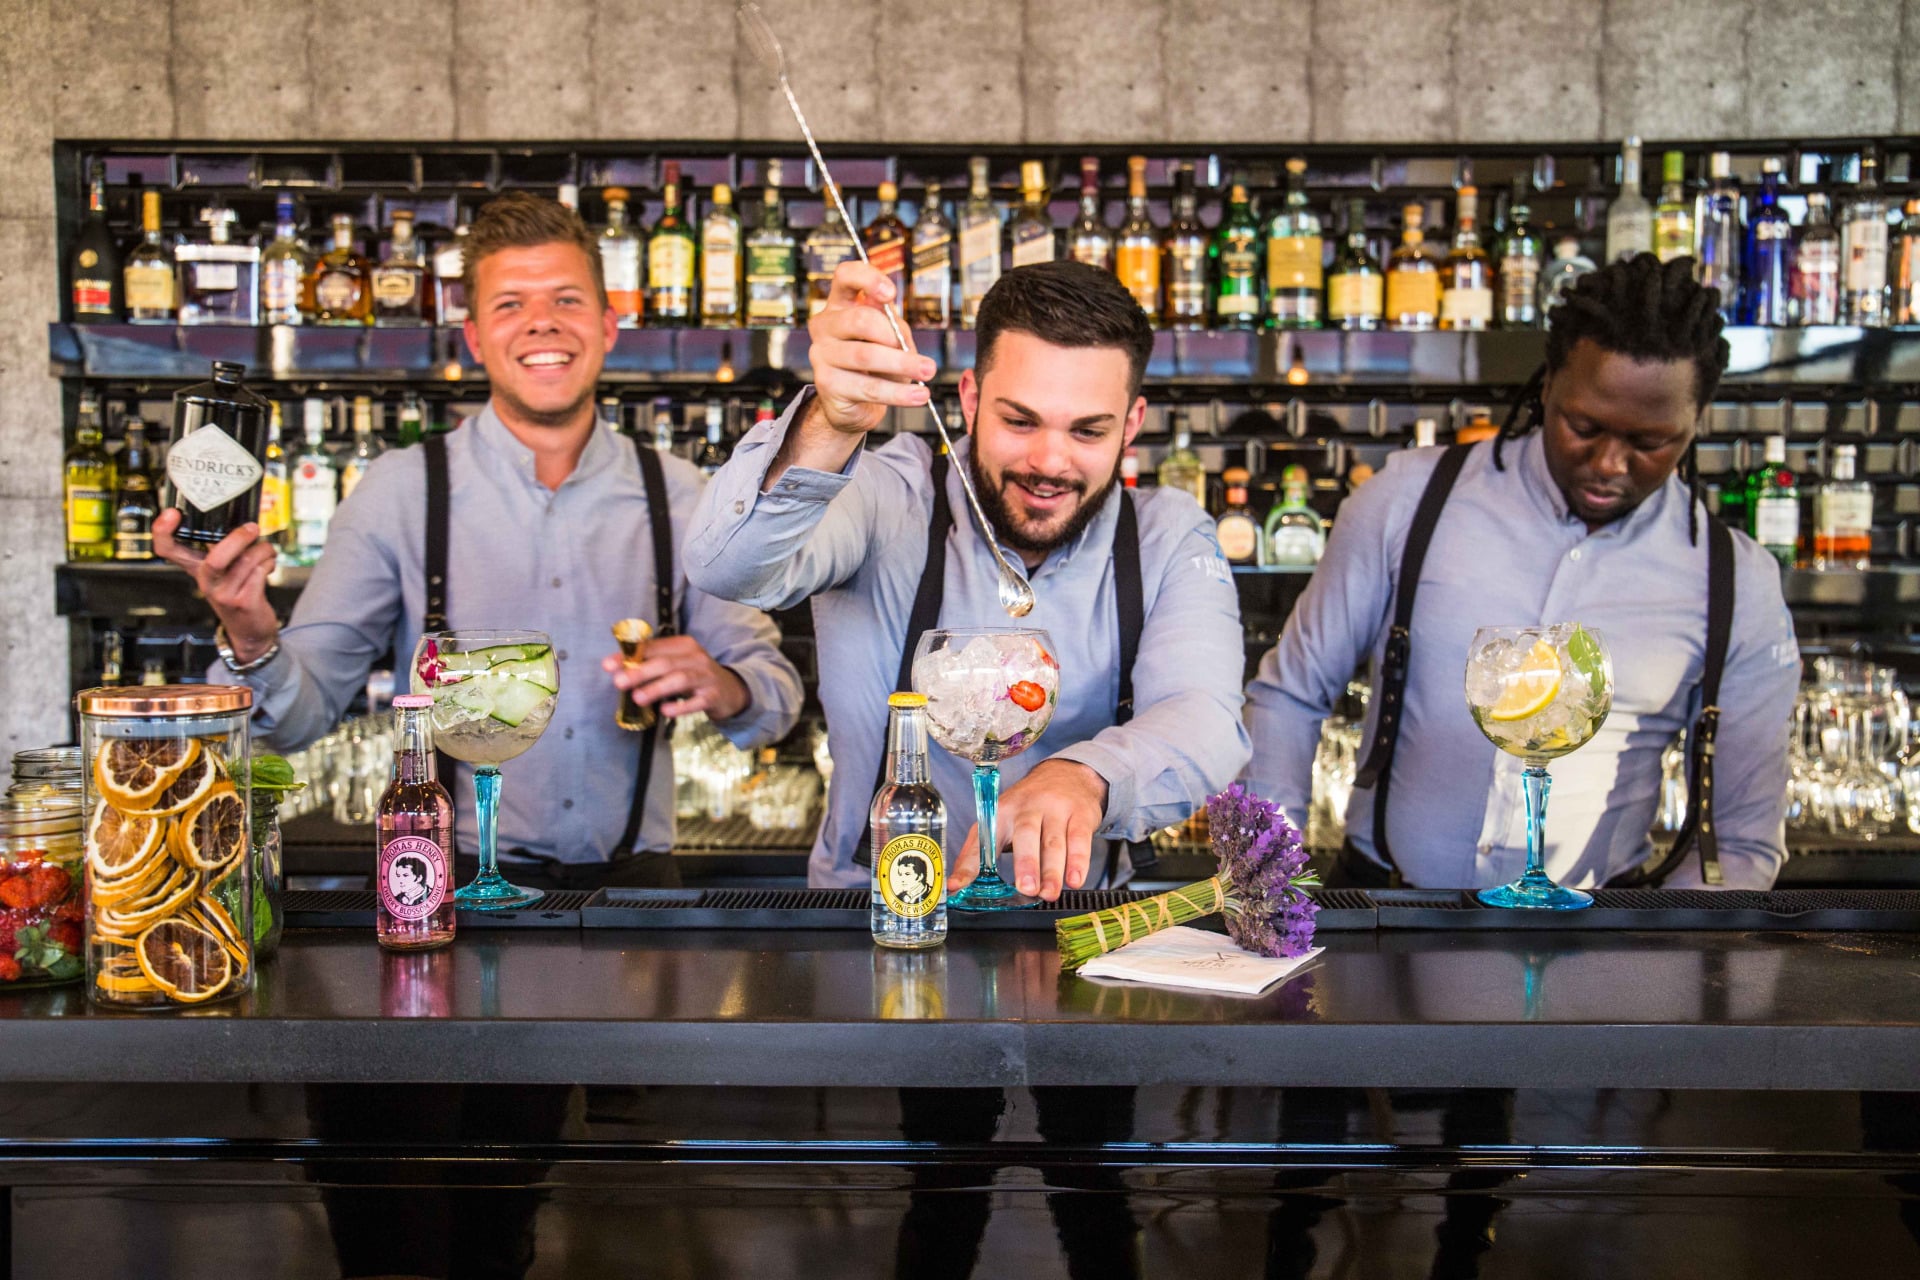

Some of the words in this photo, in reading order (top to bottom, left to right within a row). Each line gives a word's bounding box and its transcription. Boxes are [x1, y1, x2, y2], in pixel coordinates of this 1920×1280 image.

[192, 477, 221, 487] GIN
[384, 841, 413, 864] THOMAS
[415, 841, 441, 863] HENRY
[884, 839, 914, 862] THOMAS
[917, 839, 939, 860] HENRY
[383, 886, 399, 910] CHERRY
[399, 904, 431, 915] BLOSSOM
[430, 885, 442, 905] TONIC
[892, 899, 911, 913] TONIC
[912, 898, 933, 913] WATER
